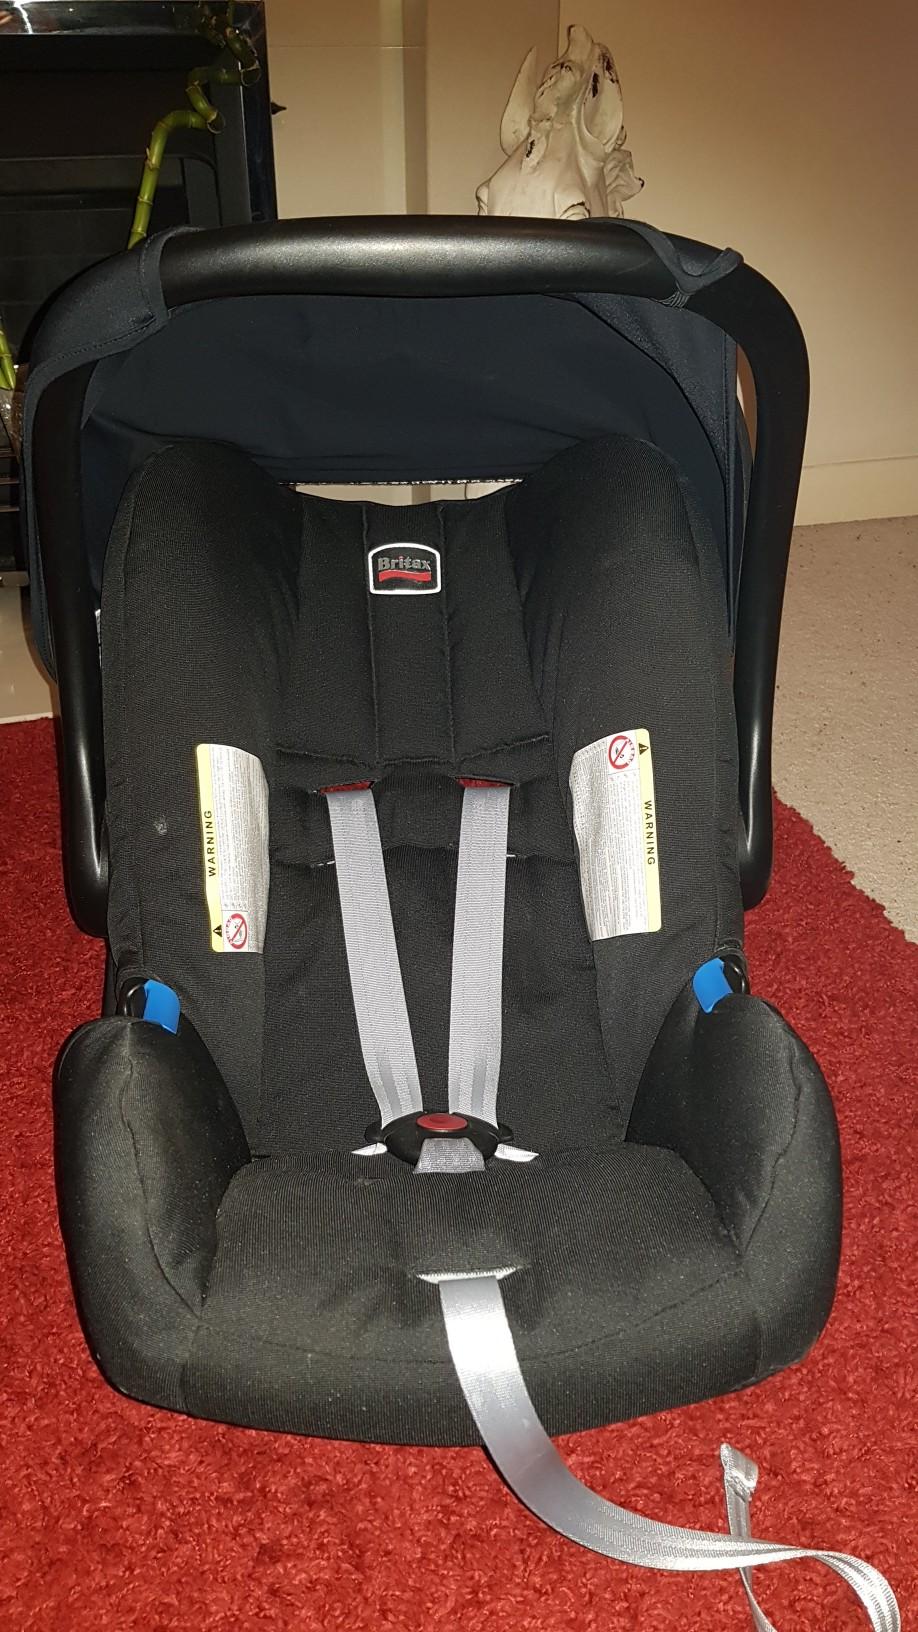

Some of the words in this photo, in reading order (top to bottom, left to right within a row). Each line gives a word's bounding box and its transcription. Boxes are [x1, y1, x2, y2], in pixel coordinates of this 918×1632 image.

[378, 555, 431, 571] Britax
[203, 810, 217, 877] WARNING
[644, 800, 655, 865] WARNING
